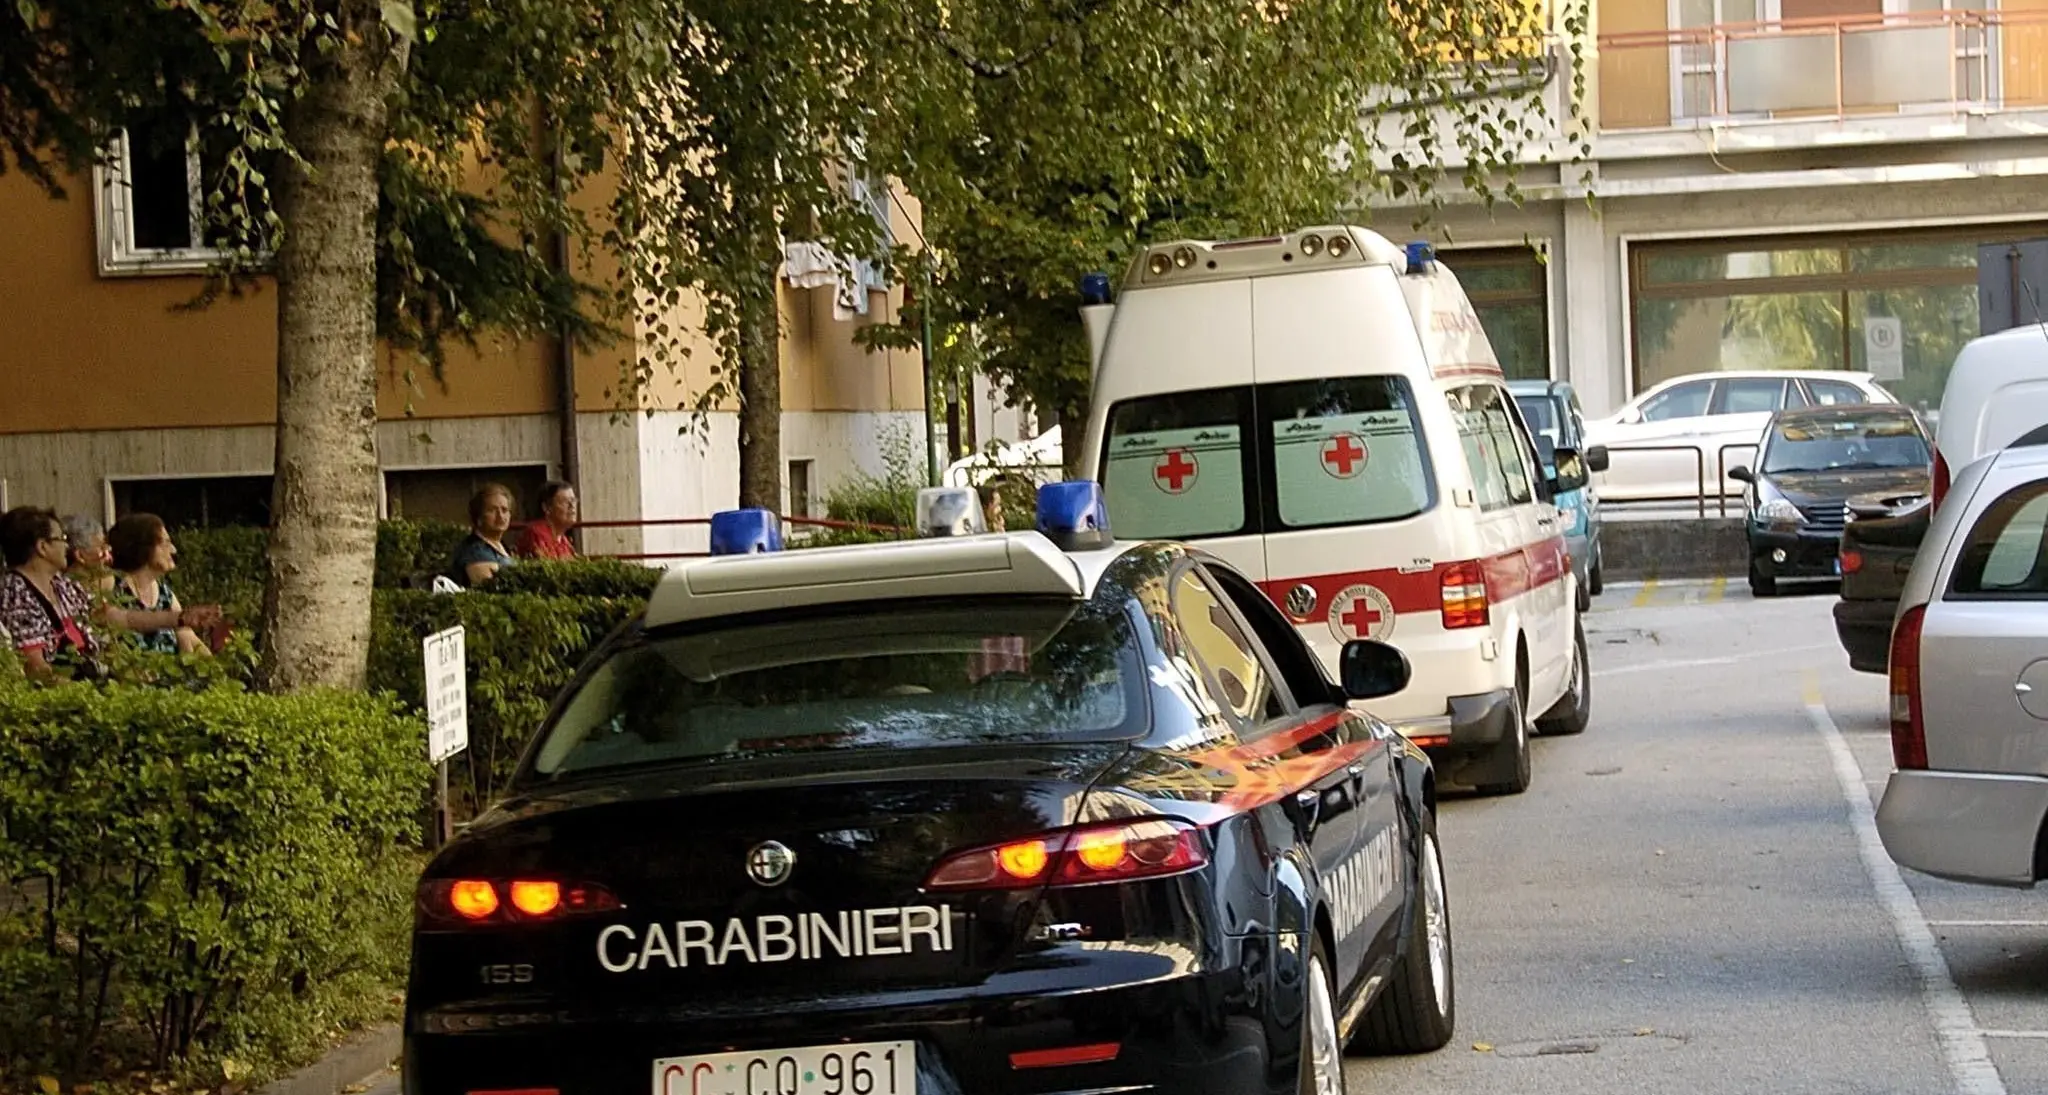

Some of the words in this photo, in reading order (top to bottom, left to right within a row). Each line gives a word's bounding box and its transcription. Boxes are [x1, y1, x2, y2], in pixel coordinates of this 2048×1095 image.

[597, 904, 954, 973] CARABINIERI
[481, 963, 534, 984] 159
[663, 1064, 714, 1095] CC
[746, 1055, 798, 1095] CQ
[821, 1049, 897, 1095] 961
